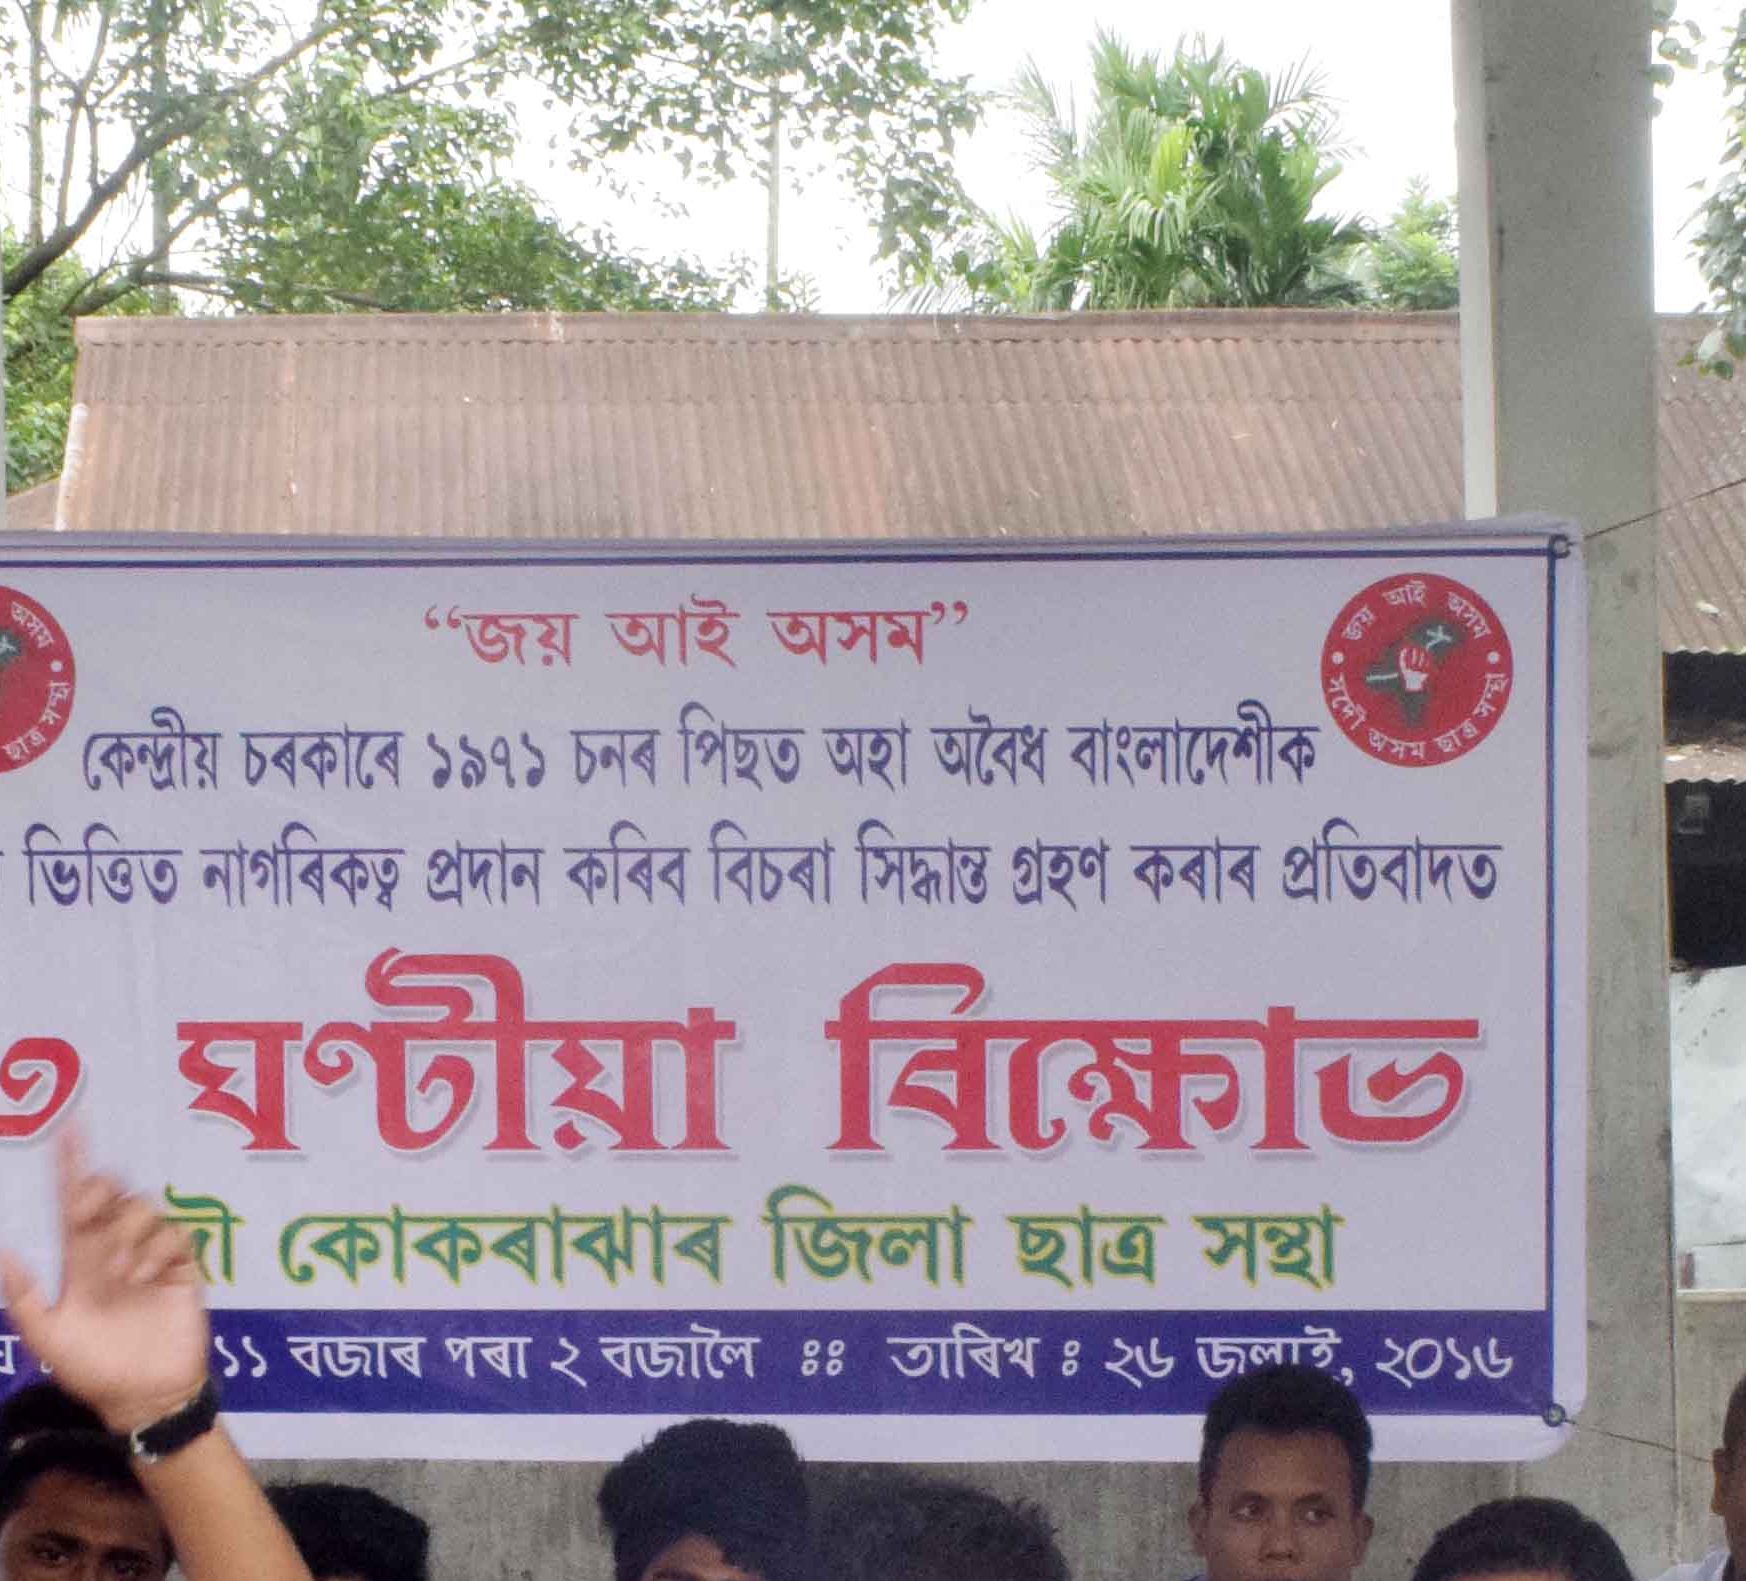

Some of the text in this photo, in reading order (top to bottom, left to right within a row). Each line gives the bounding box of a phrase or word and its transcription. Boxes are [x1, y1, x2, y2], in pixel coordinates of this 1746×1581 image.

[604, 592, 742, 668] আই
[239, 723, 406, 790] চৰকাৰে
[426, 731, 546, 790] ১৯৭১
[568, 728, 662, 788] চনৰ
[676, 700, 806, 792] পিছত
[821, 718, 912, 793] অহা
[929, 703, 1050, 787] অবৈধ
[1065, 699, 1322, 790] বাংলাদেশীক
[20, 821, 184, 907] ভিত্তিত
[198, 820, 406, 913] নাগৰিকত্ব
[426, 839, 546, 907] প্ৰদান
[562, 819, 692, 907] কৰিব
[706, 818, 836, 905] বিচৰা
[854, 818, 992, 905] সিদ্ধান্ত
[1011, 837, 1112, 911] গ্ৰহণ
[1128, 836, 1262, 904] কৰাৰ
[1282, 816, 1504, 905] প্ৰতিবাদত
[824, 962, 1481, 1152] বিক্ষোভ
[278, 1204, 734, 1285] কোকৰাঝাৰ
[760, 1183, 974, 1286] জিলা
[1006, 1204, 1166, 1289] ছাত্ৰ
[286, 1336, 428, 1379] বজাৰ
[444, 1336, 534, 1379] পৰা
[549, 1336, 588, 1388] ২
[598, 1322, 762, 1380] বজালৈ
[886, 1321, 1042, 1380] তাৰিখ
[1104, 1336, 1176, 1389] ২৬
[1375, 1336, 1514, 1389] ২০১৬
